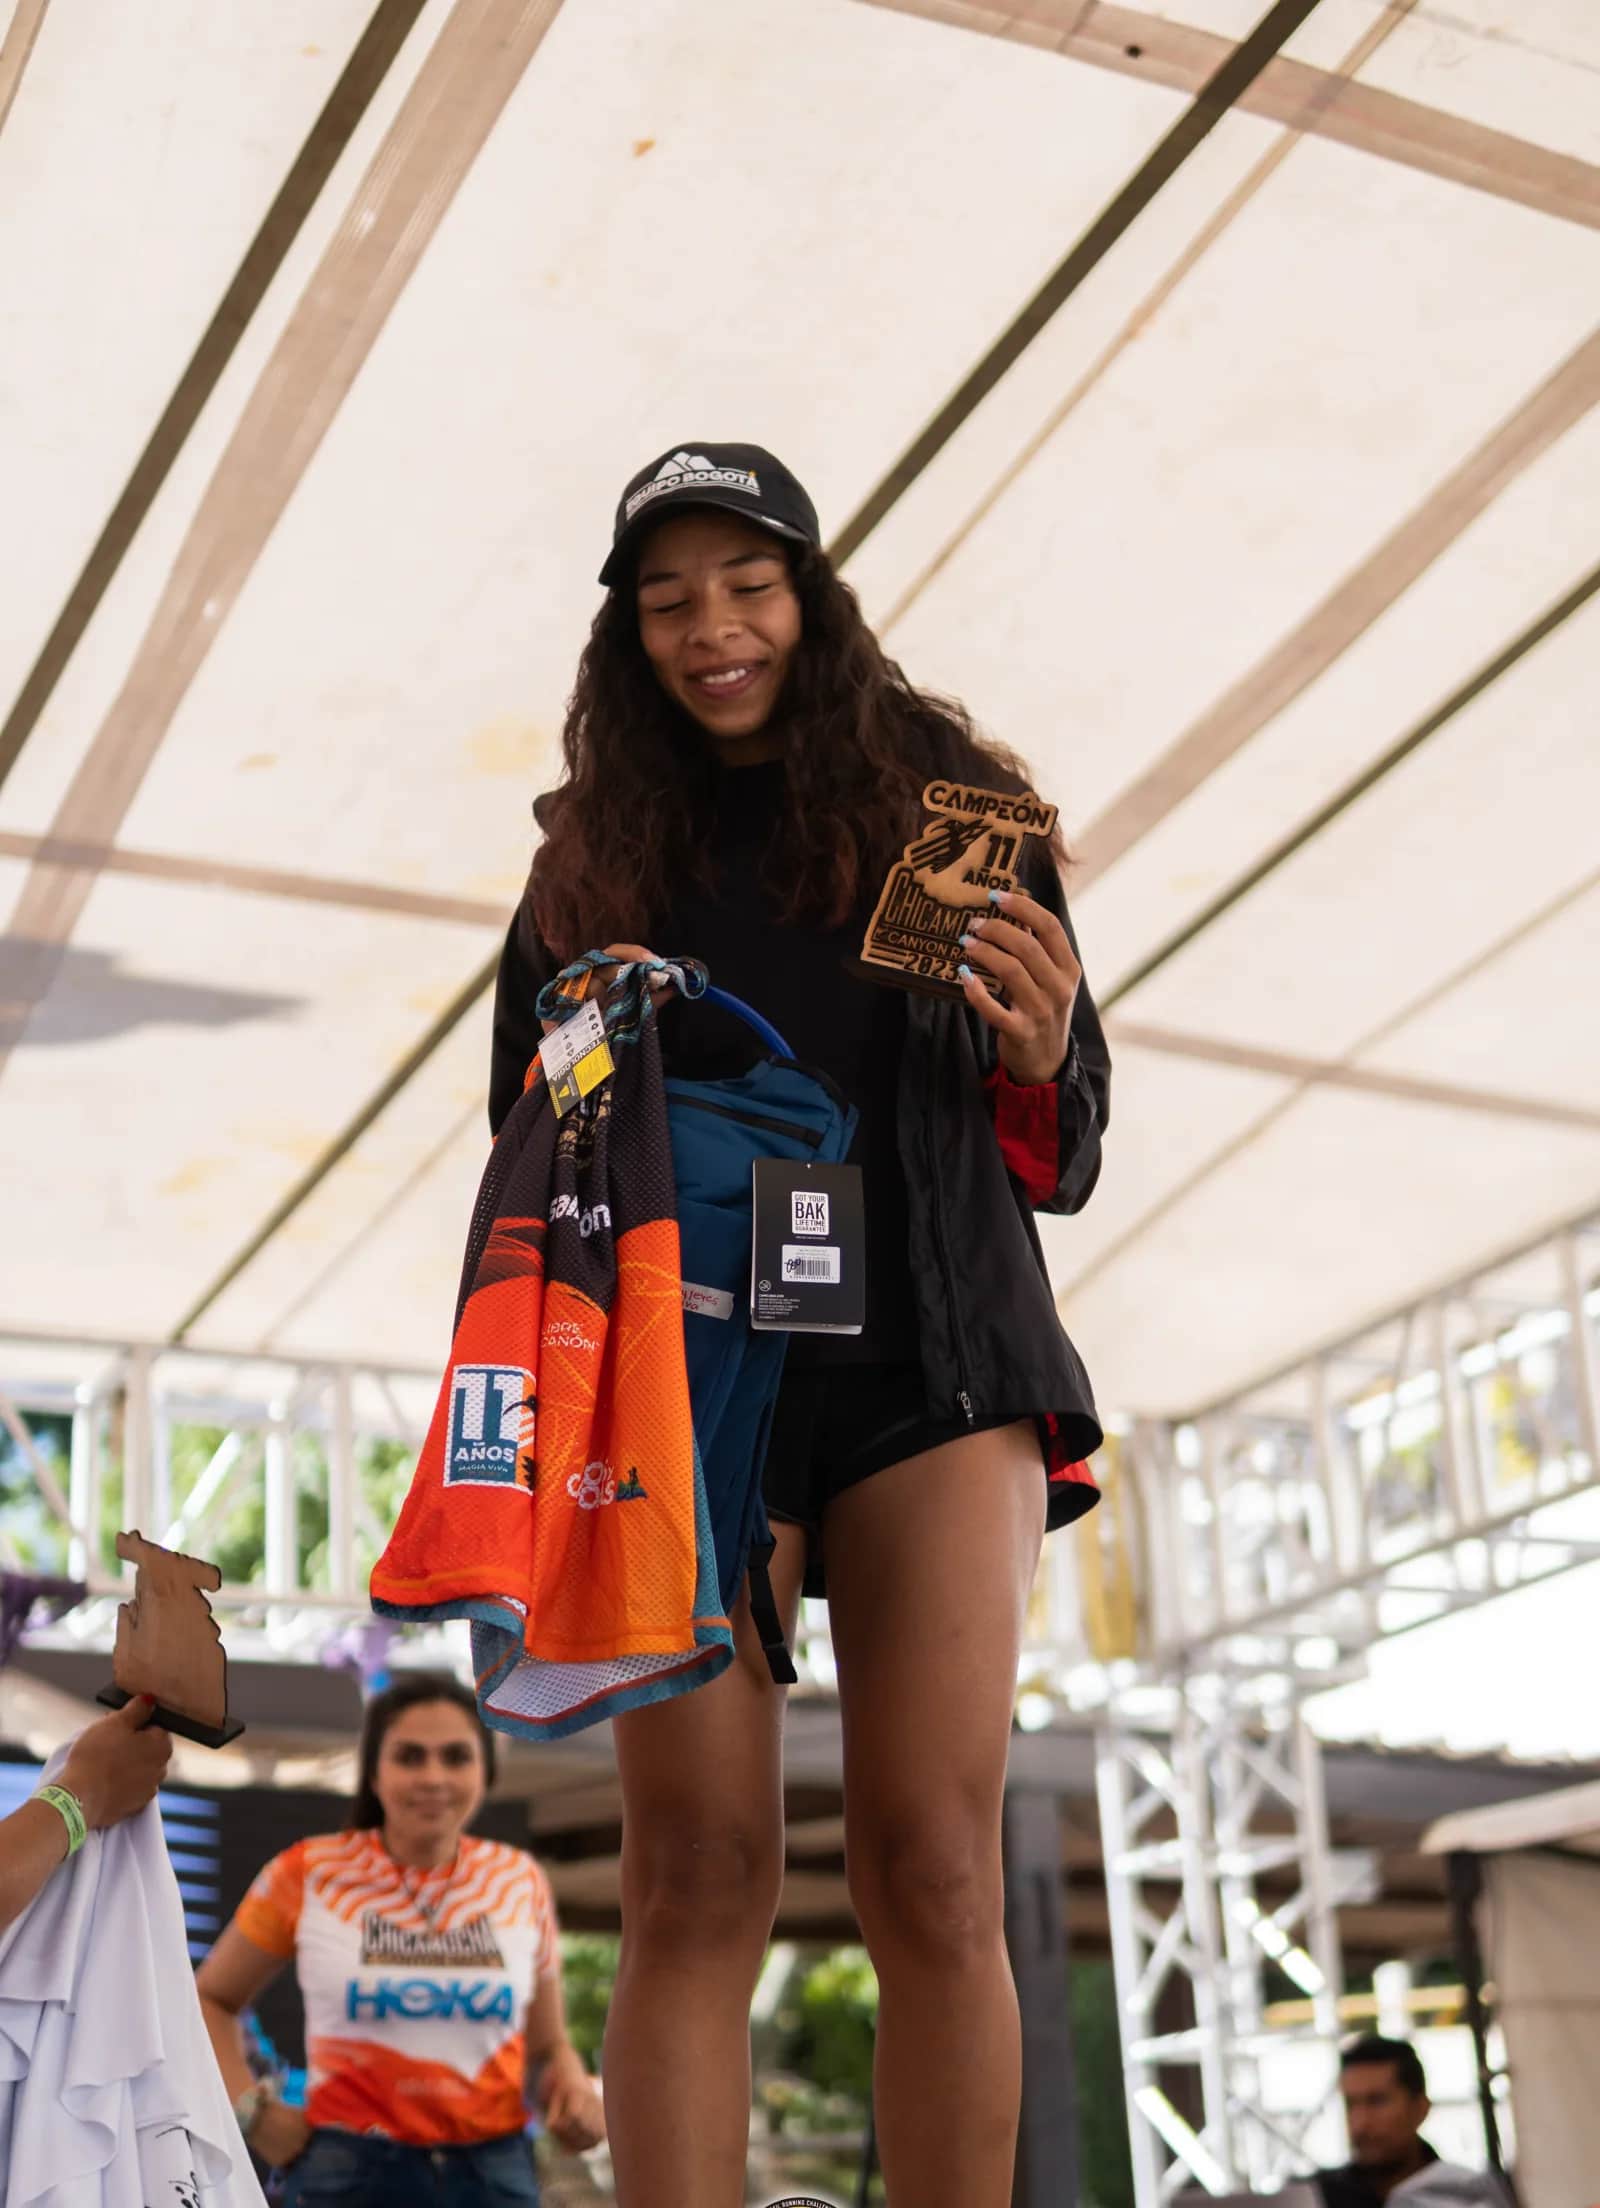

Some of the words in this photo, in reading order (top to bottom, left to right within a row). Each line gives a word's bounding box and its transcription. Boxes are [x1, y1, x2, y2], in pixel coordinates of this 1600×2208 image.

[928, 785, 1051, 829] CAMPEÓN
[984, 834, 1017, 871] 11
[962, 868, 1013, 892] AÑOS
[887, 930, 948, 956] CANYON
[904, 950, 960, 982] 2023
[794, 1194, 807, 1202] GOT
[808, 1194, 826, 1203] YOUR
[795, 1201, 825, 1220] BAK
[795, 1219, 825, 1227] LIFETIME
[455, 1371, 524, 1442] 11
[454, 1441, 515, 1463] AÑOS
[457, 1463, 486, 1473] MAGIA
[345, 1978, 514, 2024] HOKA
